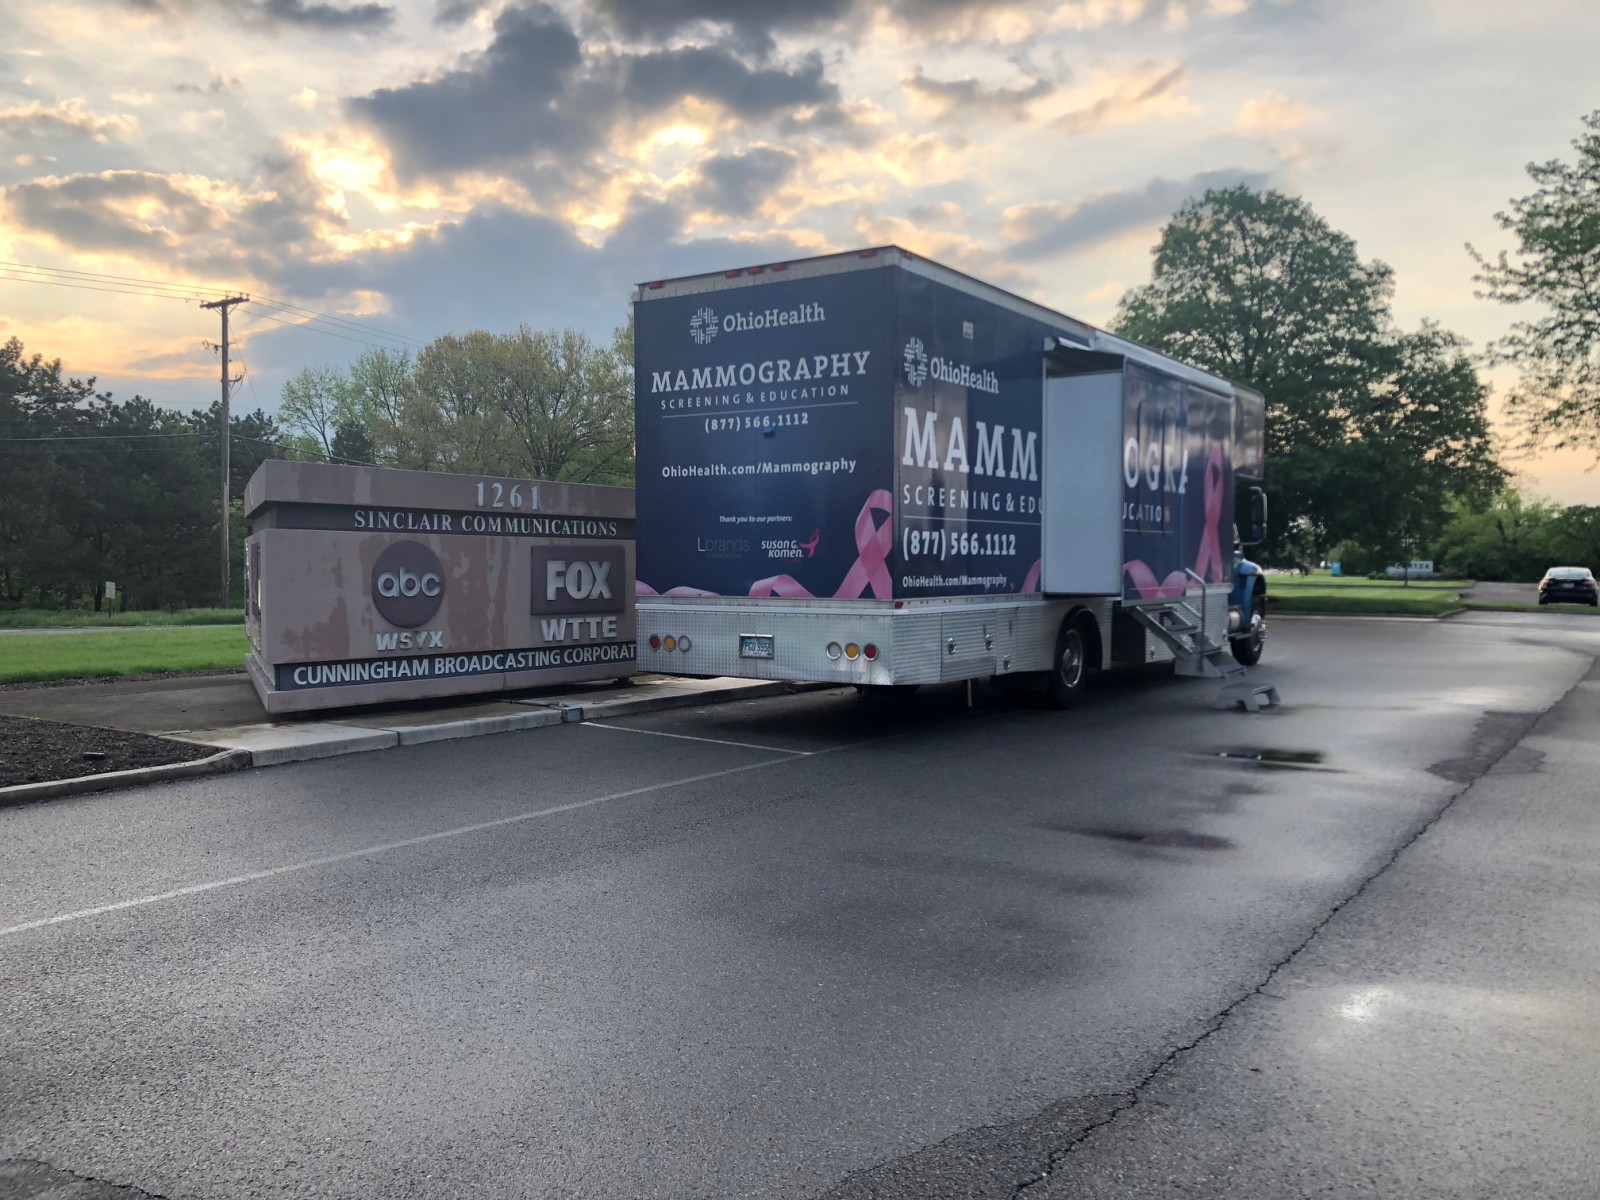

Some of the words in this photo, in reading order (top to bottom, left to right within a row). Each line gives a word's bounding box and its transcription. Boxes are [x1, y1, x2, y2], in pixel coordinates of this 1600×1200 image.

[723, 303, 826, 332] OhioHealth
[651, 351, 870, 393] MAMMOGRAPHY
[930, 357, 999, 394] OhioHealth
[661, 394, 740, 410] SCREENING
[746, 392, 754, 403] &
[760, 385, 849, 402] EDUCATION
[704, 416, 741, 433] (877)
[745, 412, 809, 428] 566.1112
[902, 406, 1038, 481] MAMM
[662, 457, 857, 477] OhioHealth.com/Mammography
[475, 481, 540, 510] 1261
[903, 484, 1000, 511] SCREENING
[1005, 492, 1015, 512] &
[354, 510, 452, 531] SINCLAIR
[461, 515, 617, 537] COMMUNICATIONS
[719, 515, 736, 523] Thank
[736, 516, 748, 524] you
[766, 515, 793, 524] partners:
[903, 527, 946, 561] (877)
[950, 531, 1016, 556] 566.1112
[377, 565, 441, 598] abc
[546, 560, 613, 601] FOX
[902, 573, 1007, 588] OhioHealth.com/Mammography
[376, 630, 444, 651] WSYX
[540, 616, 618, 642] WTTE
[293, 658, 429, 685] CUNNINGHAM
[434, 650, 560, 675] BROADCASTING
